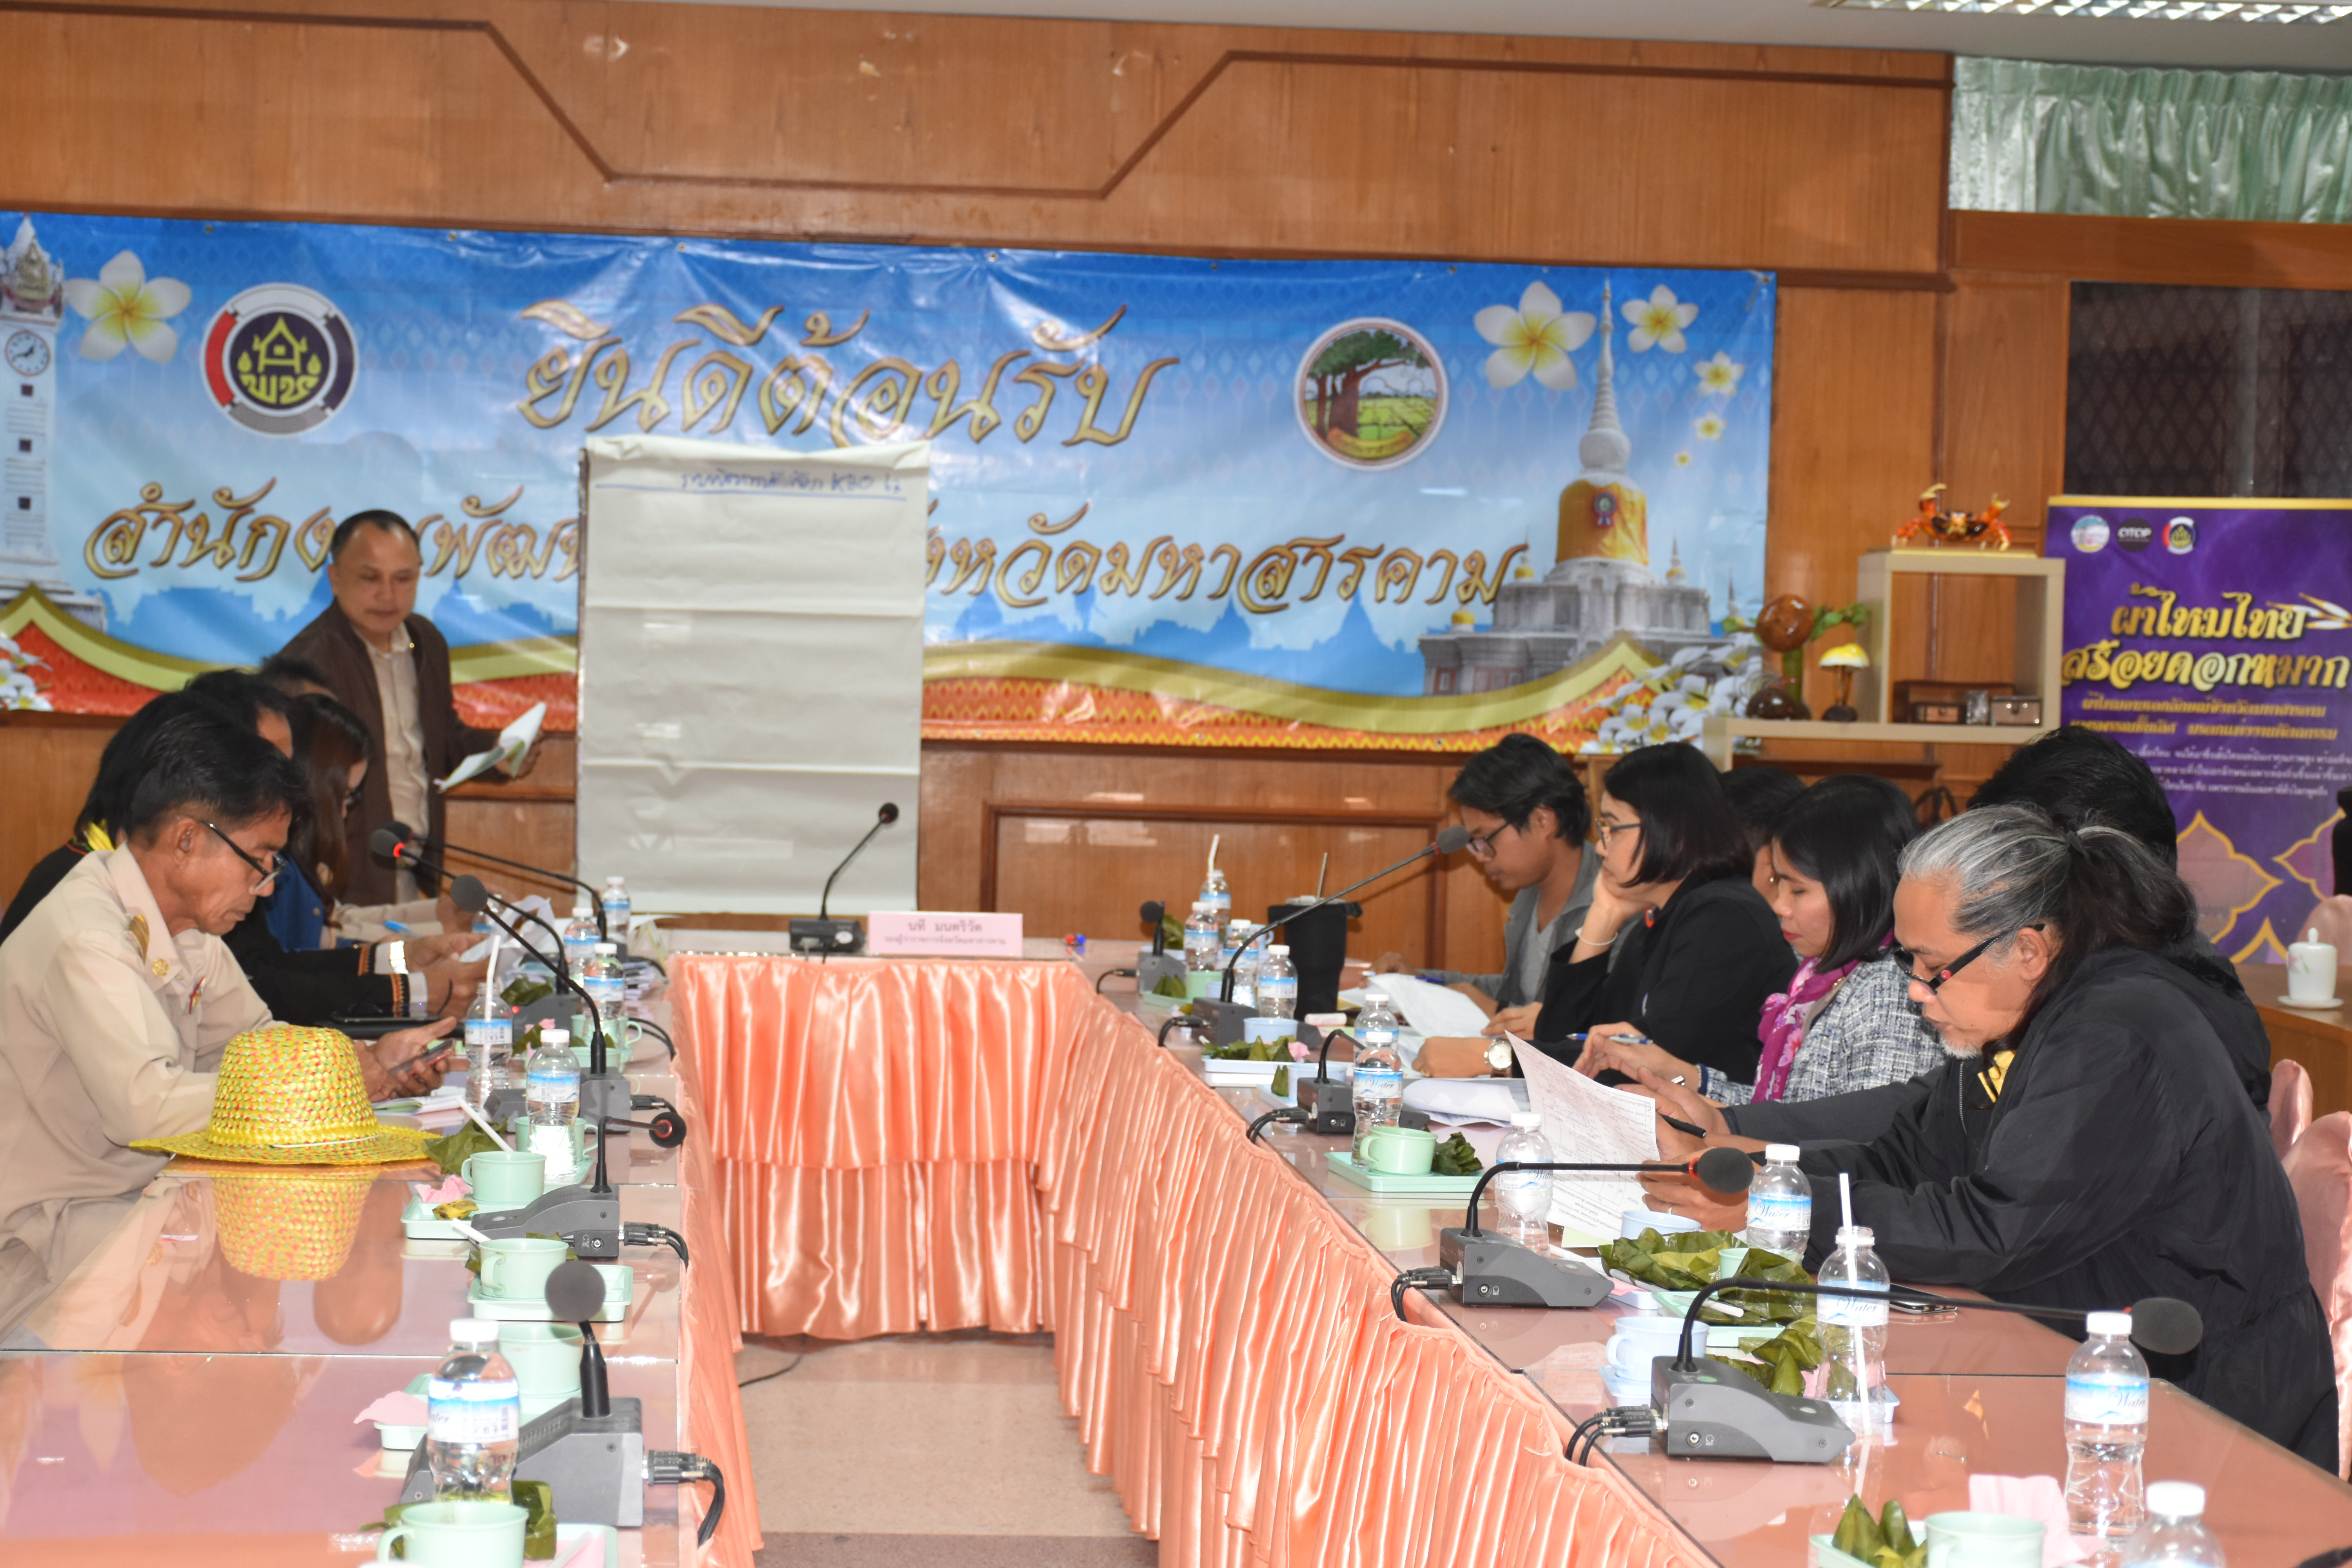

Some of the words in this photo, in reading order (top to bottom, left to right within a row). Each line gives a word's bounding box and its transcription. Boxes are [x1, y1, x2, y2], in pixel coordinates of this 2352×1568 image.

[517, 298, 1180, 447] ยินดีต้อนรับ
[2118, 527, 2152, 538] OTOP
[2112, 582, 2307, 638] ผ้าไหมไทย
[2061, 639, 2350, 691] สร้อยดอกหมาก
[1366, 1077, 1394, 1088] Water
[1755, 1202, 1790, 1218] Water
[1837, 1296, 1878, 1312] Water
